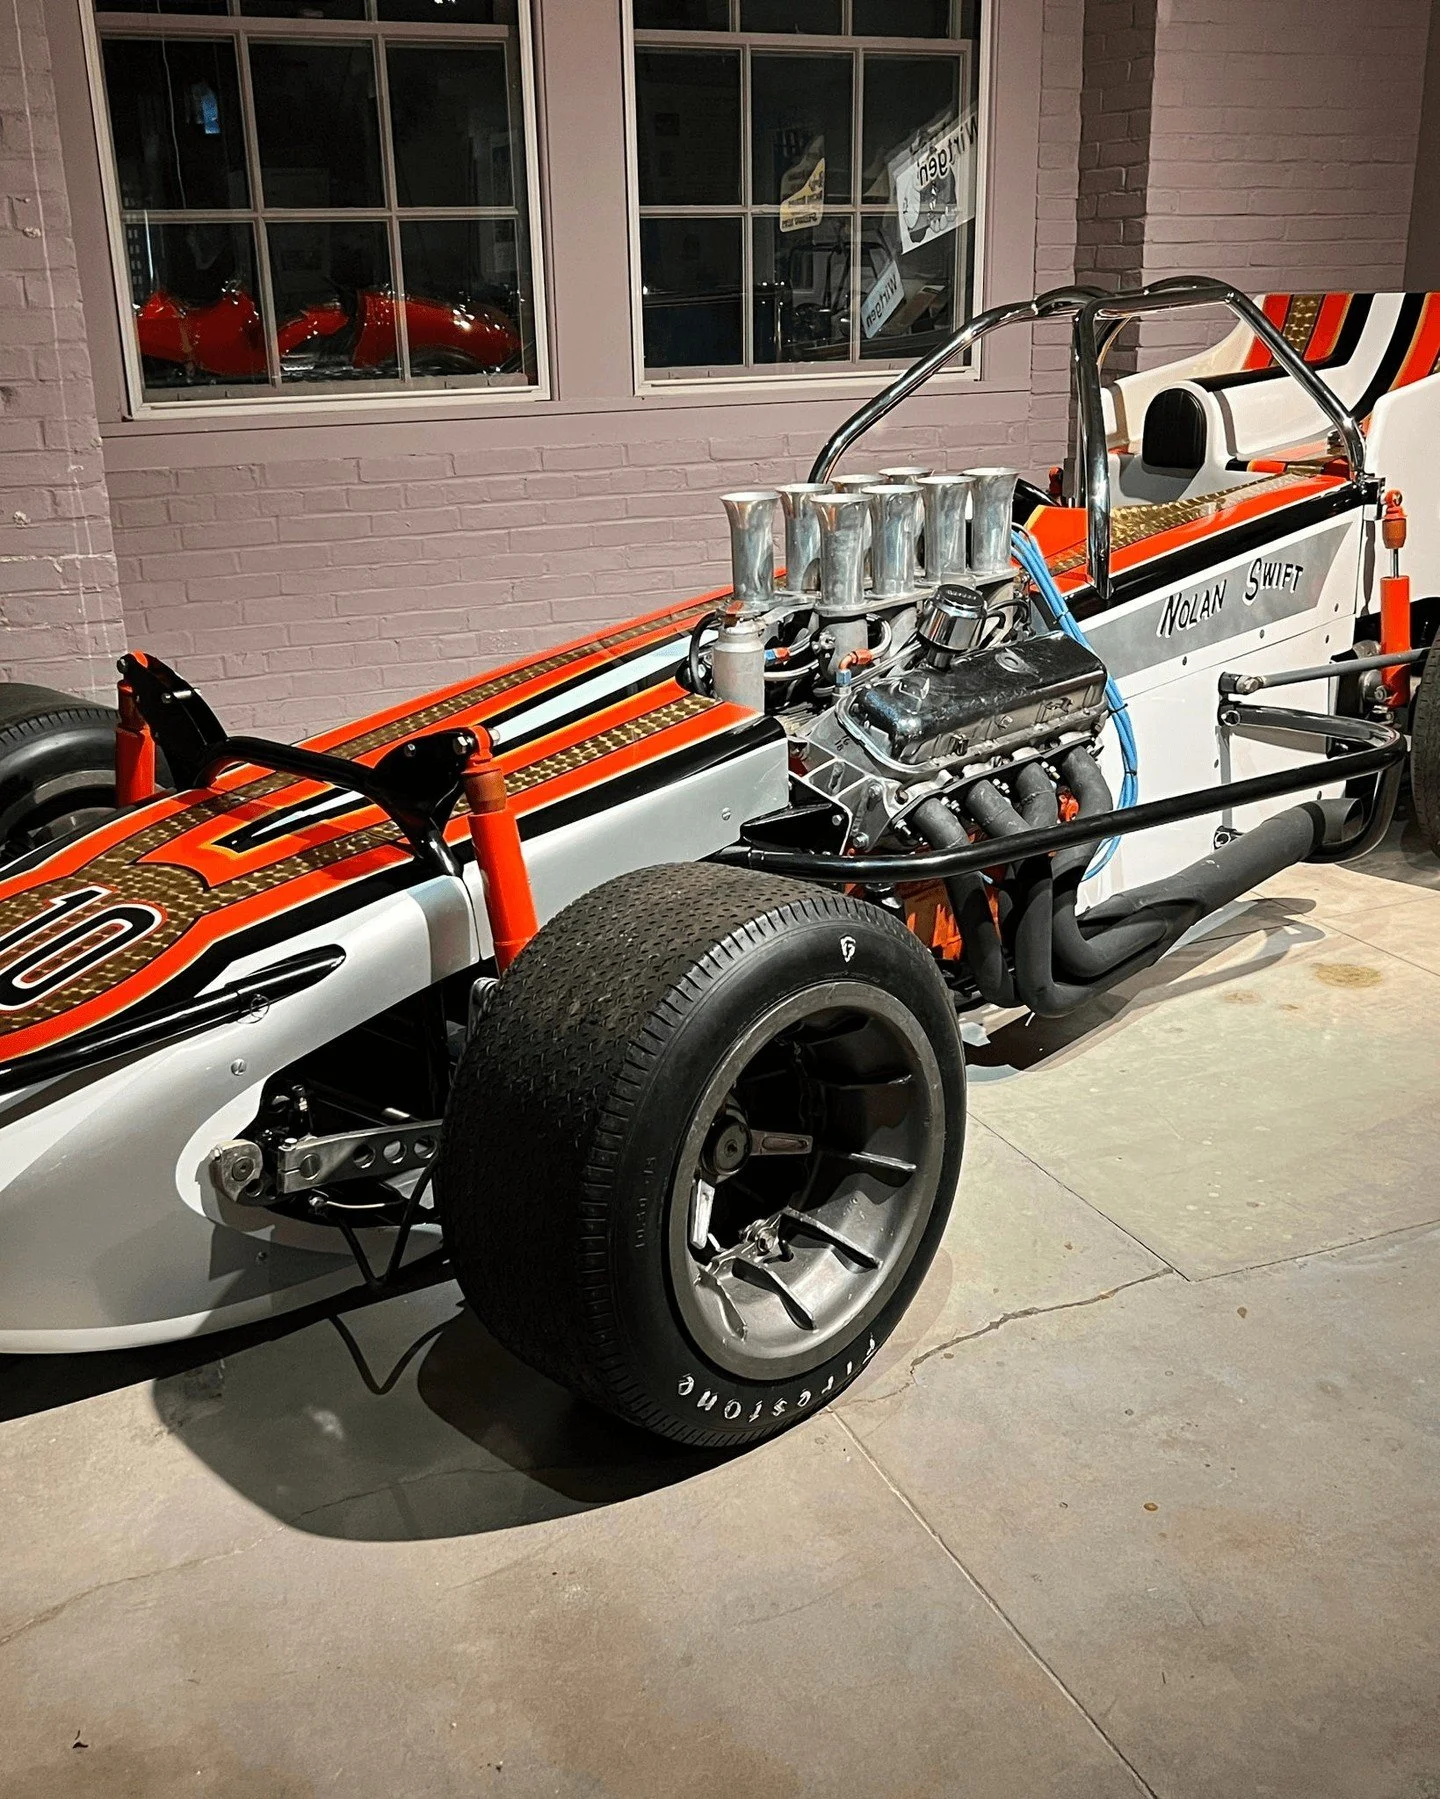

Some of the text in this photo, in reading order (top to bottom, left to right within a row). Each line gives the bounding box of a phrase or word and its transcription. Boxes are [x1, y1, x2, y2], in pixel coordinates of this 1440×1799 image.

[1156, 557, 1304, 638] NOLAN SWIFT
[0, 886, 163, 1011] 10
[678, 1333, 875, 1423] Firestone
